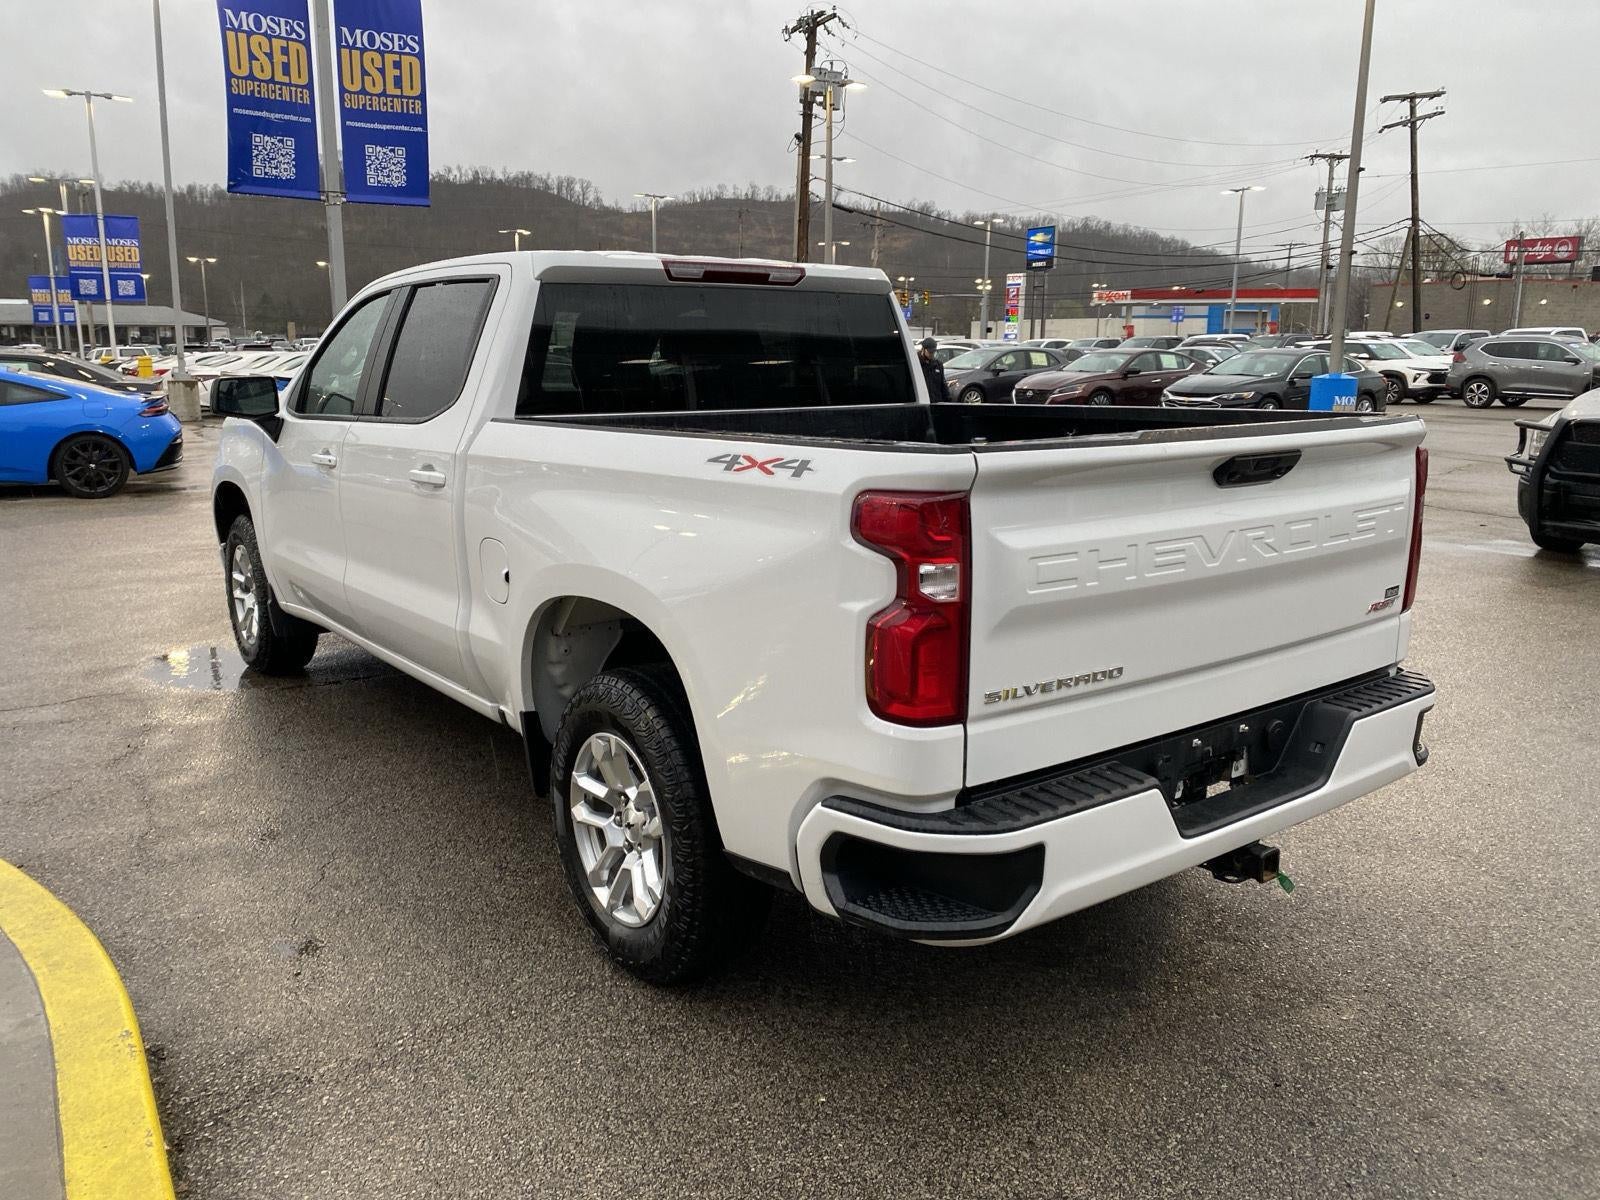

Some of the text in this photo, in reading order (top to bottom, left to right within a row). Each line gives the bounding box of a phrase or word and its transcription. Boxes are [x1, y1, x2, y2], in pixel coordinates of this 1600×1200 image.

[223, 8, 306, 41] MOSES
[340, 26, 420, 54] MOSES
[226, 31, 309, 86] USED
[341, 48, 421, 97] USED
[231, 78, 310, 105] SUPERCENTER
[344, 92, 422, 115] SUPERCENTER
[67, 236, 100, 246] MOSES
[67, 245, 101, 261] USED
[106, 238, 139, 247] MOSES
[107, 246, 140, 262] USED
[1026, 501, 1404, 594] CHEVROLET
[984, 666, 1124, 704] SILVERADO
